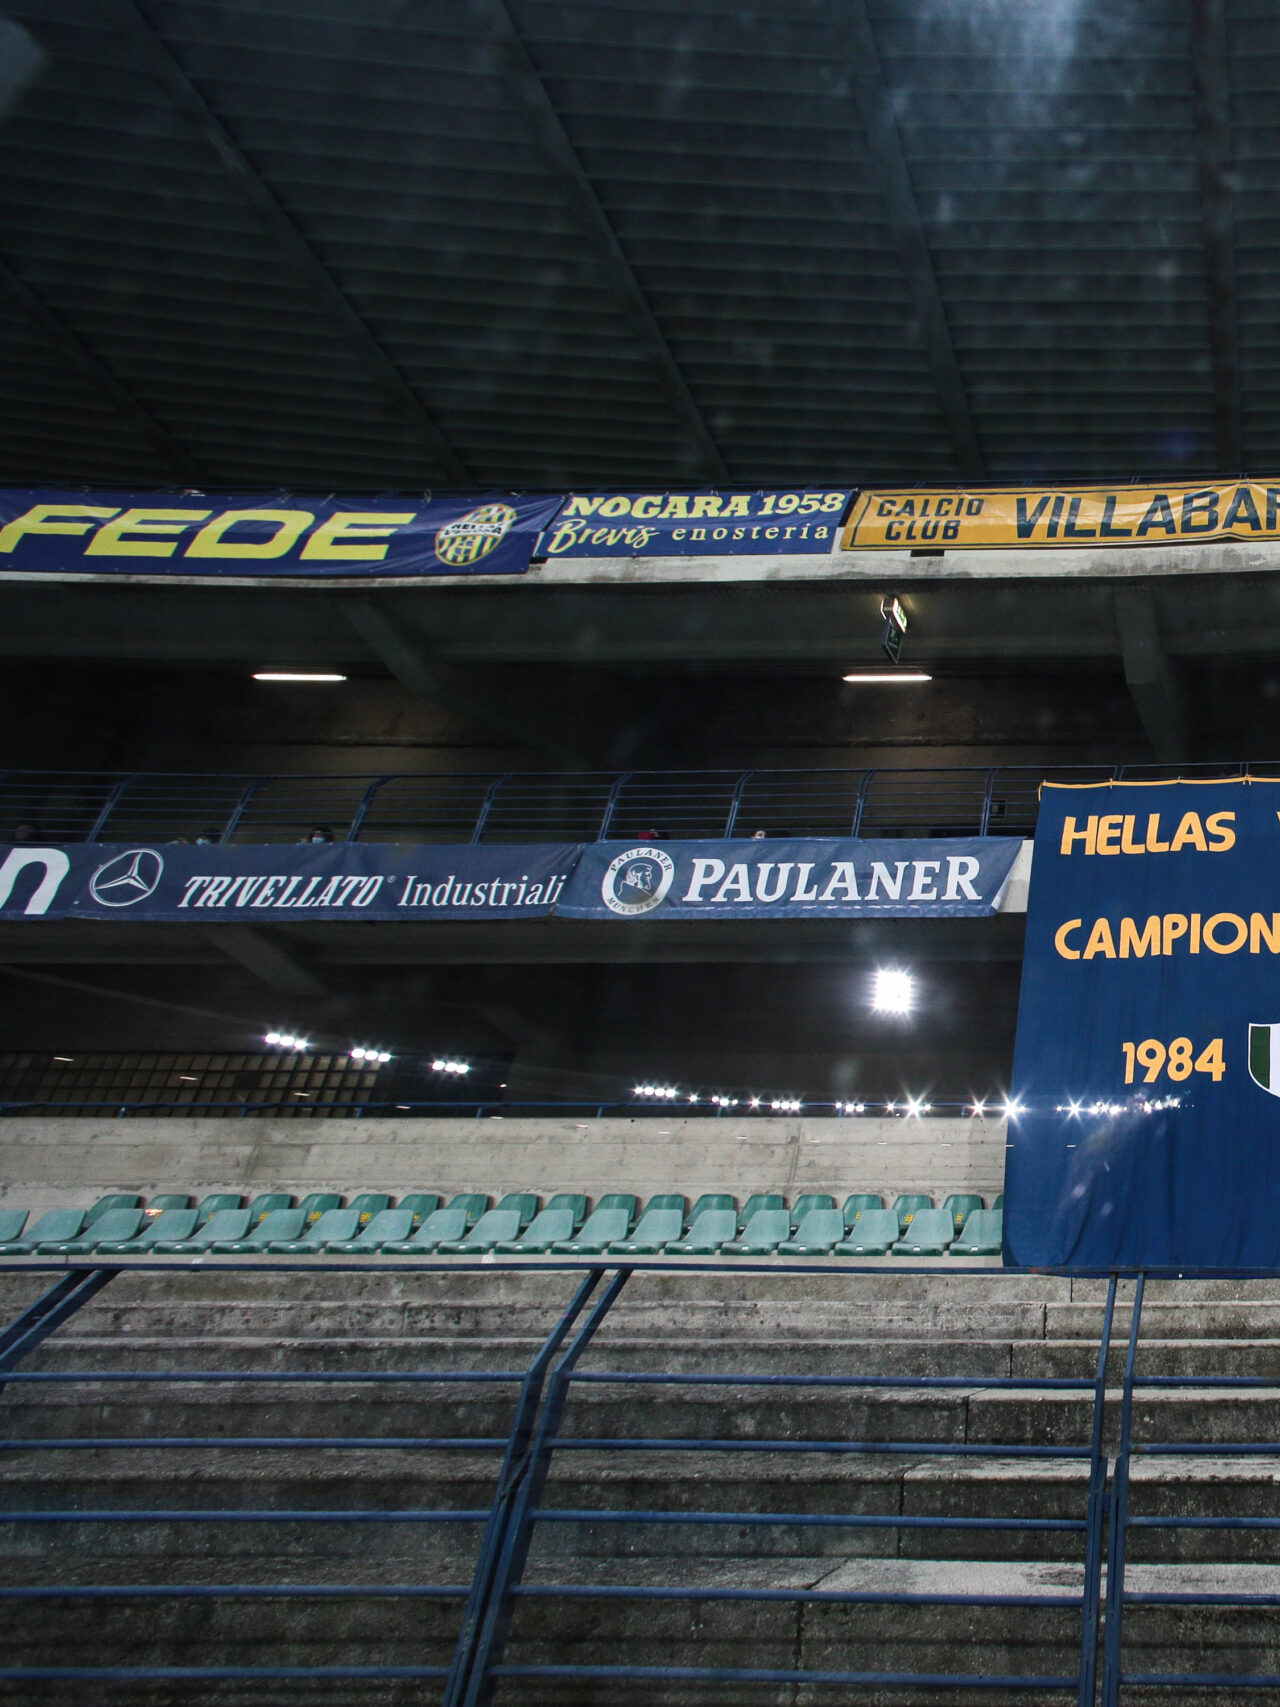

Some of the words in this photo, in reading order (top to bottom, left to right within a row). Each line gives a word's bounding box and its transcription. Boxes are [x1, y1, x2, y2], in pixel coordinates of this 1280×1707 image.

[562, 496, 750, 518] NOGARA
[757, 493, 846, 516] 1958
[876, 498, 984, 517] CALCIO
[0, 504, 416, 560] FEDE
[547, 518, 660, 553] Brevis
[671, 523, 829, 541] enosteria
[885, 519, 961, 540] CLUB
[1060, 811, 1236, 855] HELLAS
[611, 849, 672, 873] PAULANER
[177, 875, 385, 908] TRIVELLATO
[397, 874, 568, 907] Industriali
[682, 856, 982, 902] PAULANER
[1122, 1036, 1226, 1084] 1984
